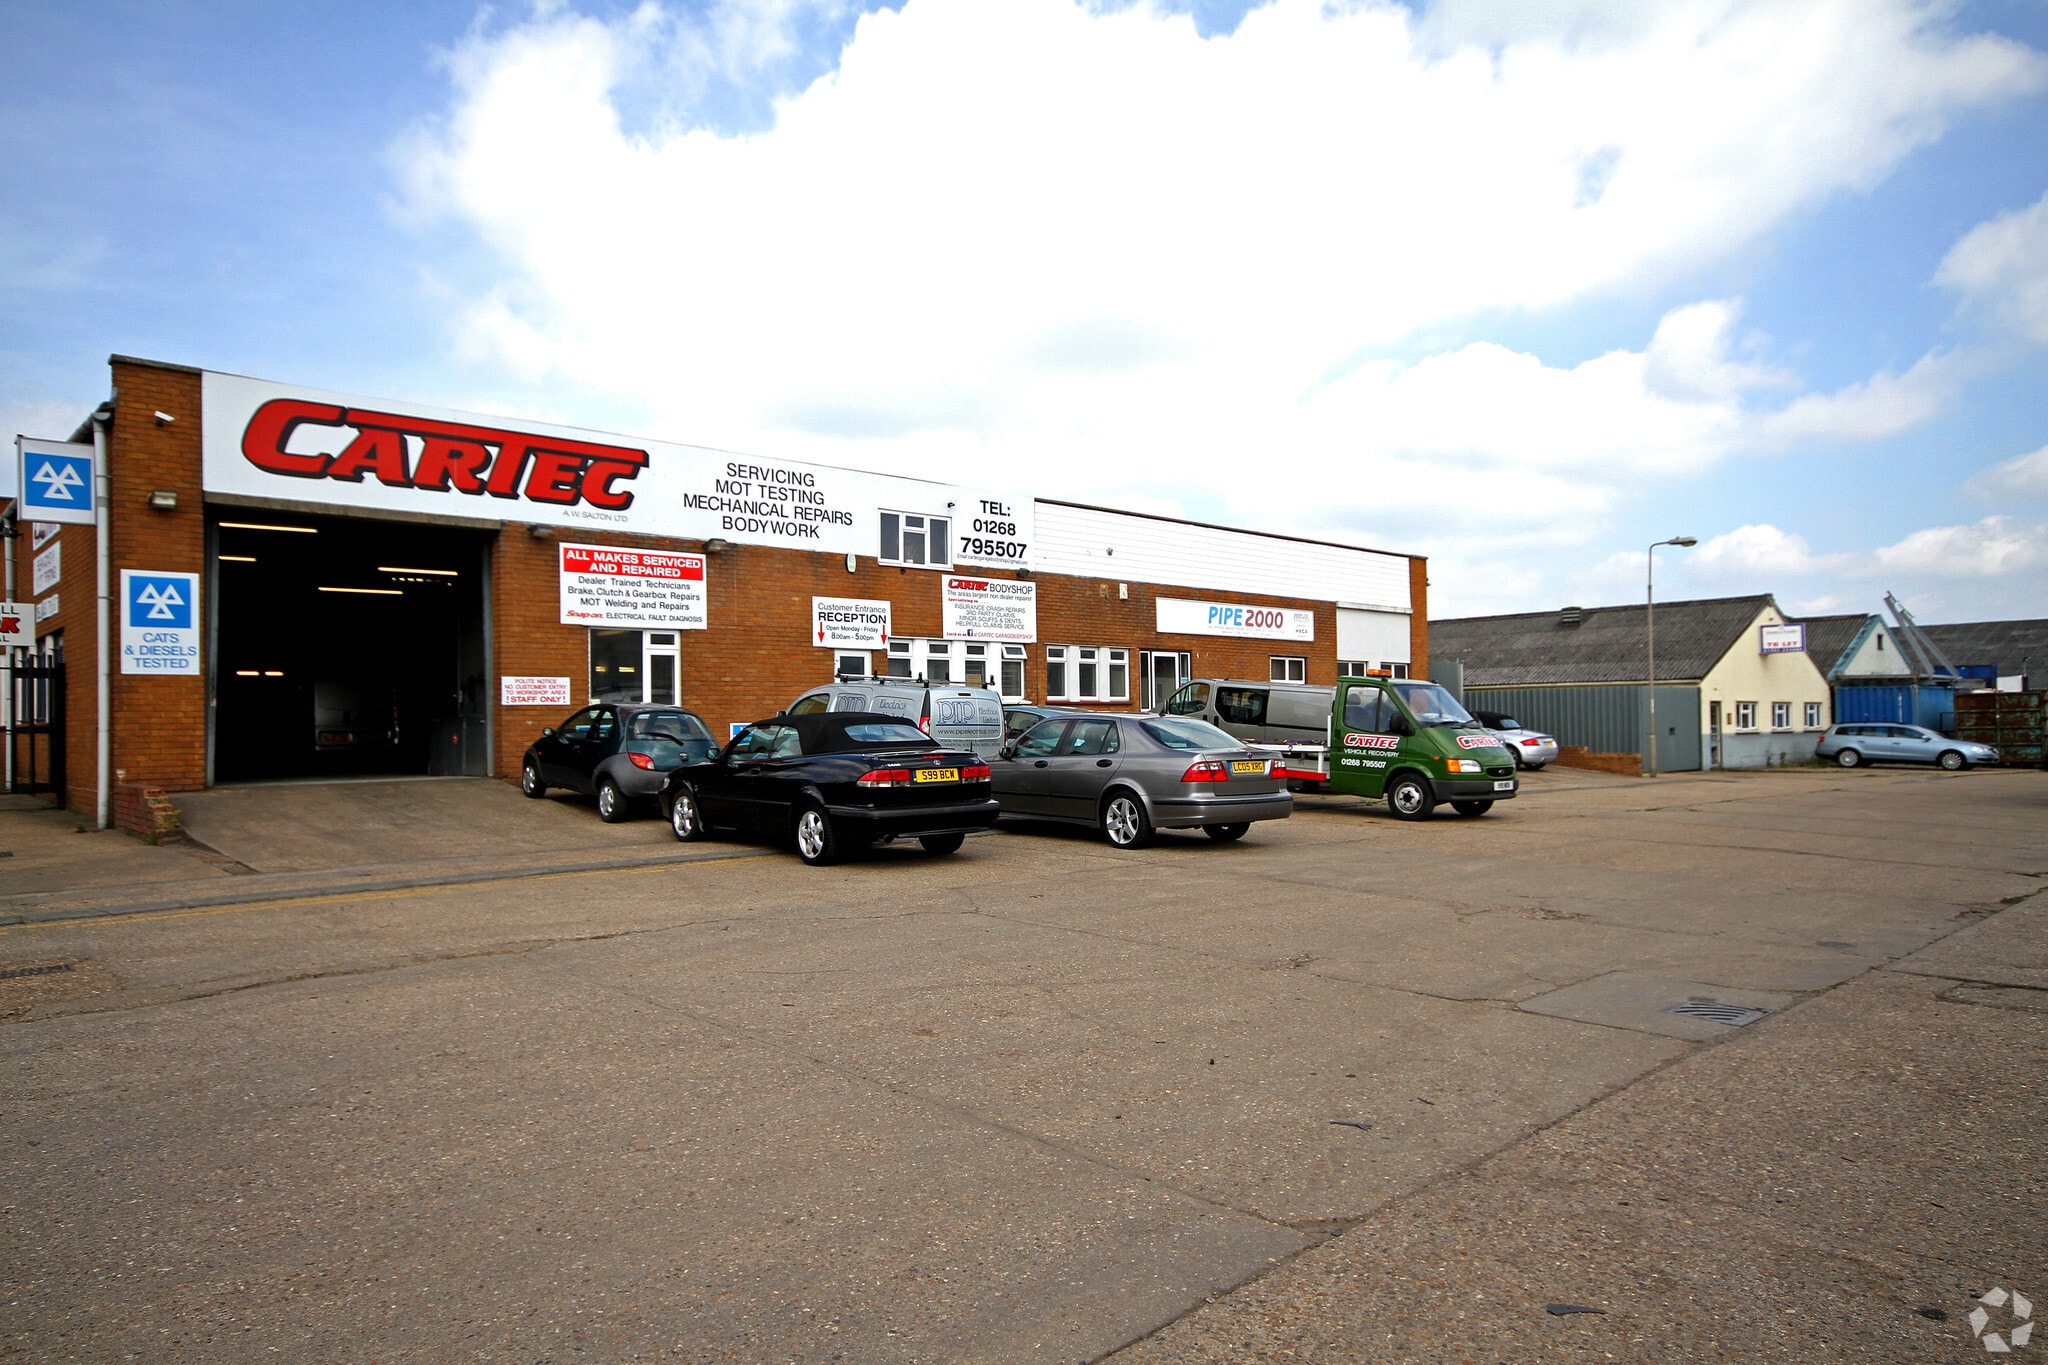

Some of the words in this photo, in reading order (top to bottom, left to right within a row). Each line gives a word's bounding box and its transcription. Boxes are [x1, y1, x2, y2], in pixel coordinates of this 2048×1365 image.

[241, 398, 650, 511] CARTEC
[726, 462, 815, 488] SERVICING
[715, 479, 752, 496] MOT
[757, 484, 825, 506] TESTING
[683, 493, 789, 518] MECHANICAL
[794, 506, 853, 526] REPAIRS
[979, 499, 1011, 517] TEL:
[581, 511, 612, 521] SALTON
[613, 514, 629, 523] LTD
[722, 515, 820, 539] BODYWORK
[973, 518, 1016, 536] 01268
[960, 536, 1027, 559] 795507
[566, 549, 591, 561] ALL
[593, 551, 639, 564] MAKES
[642, 555, 701, 569] SERVICED
[589, 562, 618, 574] AND
[621, 565, 682, 578] REPAIRED
[578, 575, 606, 586] Dealer
[610, 577, 642, 588] Trained
[645, 579, 691, 590] Technicians
[948, 578, 990, 591] CARTEC
[989, 583, 1033, 595] BODYSHOP
[596, 588, 624, 598] Clutch
[625, 589, 631, 597] &
[632, 589, 667, 600] Gearbox
[670, 591, 701, 602] Repairs
[947, 589, 957, 597] The
[957, 590, 972, 598] areas
[971, 591, 989, 599] largest
[580, 597, 601, 607] MOT
[604, 598, 638, 610] Welding
[640, 600, 657, 609] and
[659, 601, 690, 611] Repairs
[817, 602, 853, 612] Customer
[854, 604, 887, 614] Entrance
[954, 603, 985, 612] INSURANCE
[1005, 606, 1026, 614] REPAIRS
[606, 612, 646, 621] ELECTRICAL
[648, 614, 667, 622] FAULT
[668, 615, 703, 623] DIAGNOSIS
[818, 611, 887, 625] RECEPTION
[1208, 606, 1243, 626] PIPE
[1244, 609, 1284, 629] 2000
[825, 624, 840, 632] Open
[142, 632, 180, 644] CATS
[831, 631, 851, 640] 8.00am
[855, 632, 875, 641] 5.00pm
[124, 644, 134, 655] &
[139, 644, 197, 656] DIESELS
[133, 657, 190, 669] TESTED
[1344, 733, 1399, 749] CARTEC
[1341, 758, 1361, 767] 01268
[1361, 759, 1387, 768] 795507
[921, 770, 938, 780] S99
[940, 769, 955, 780] BCW
